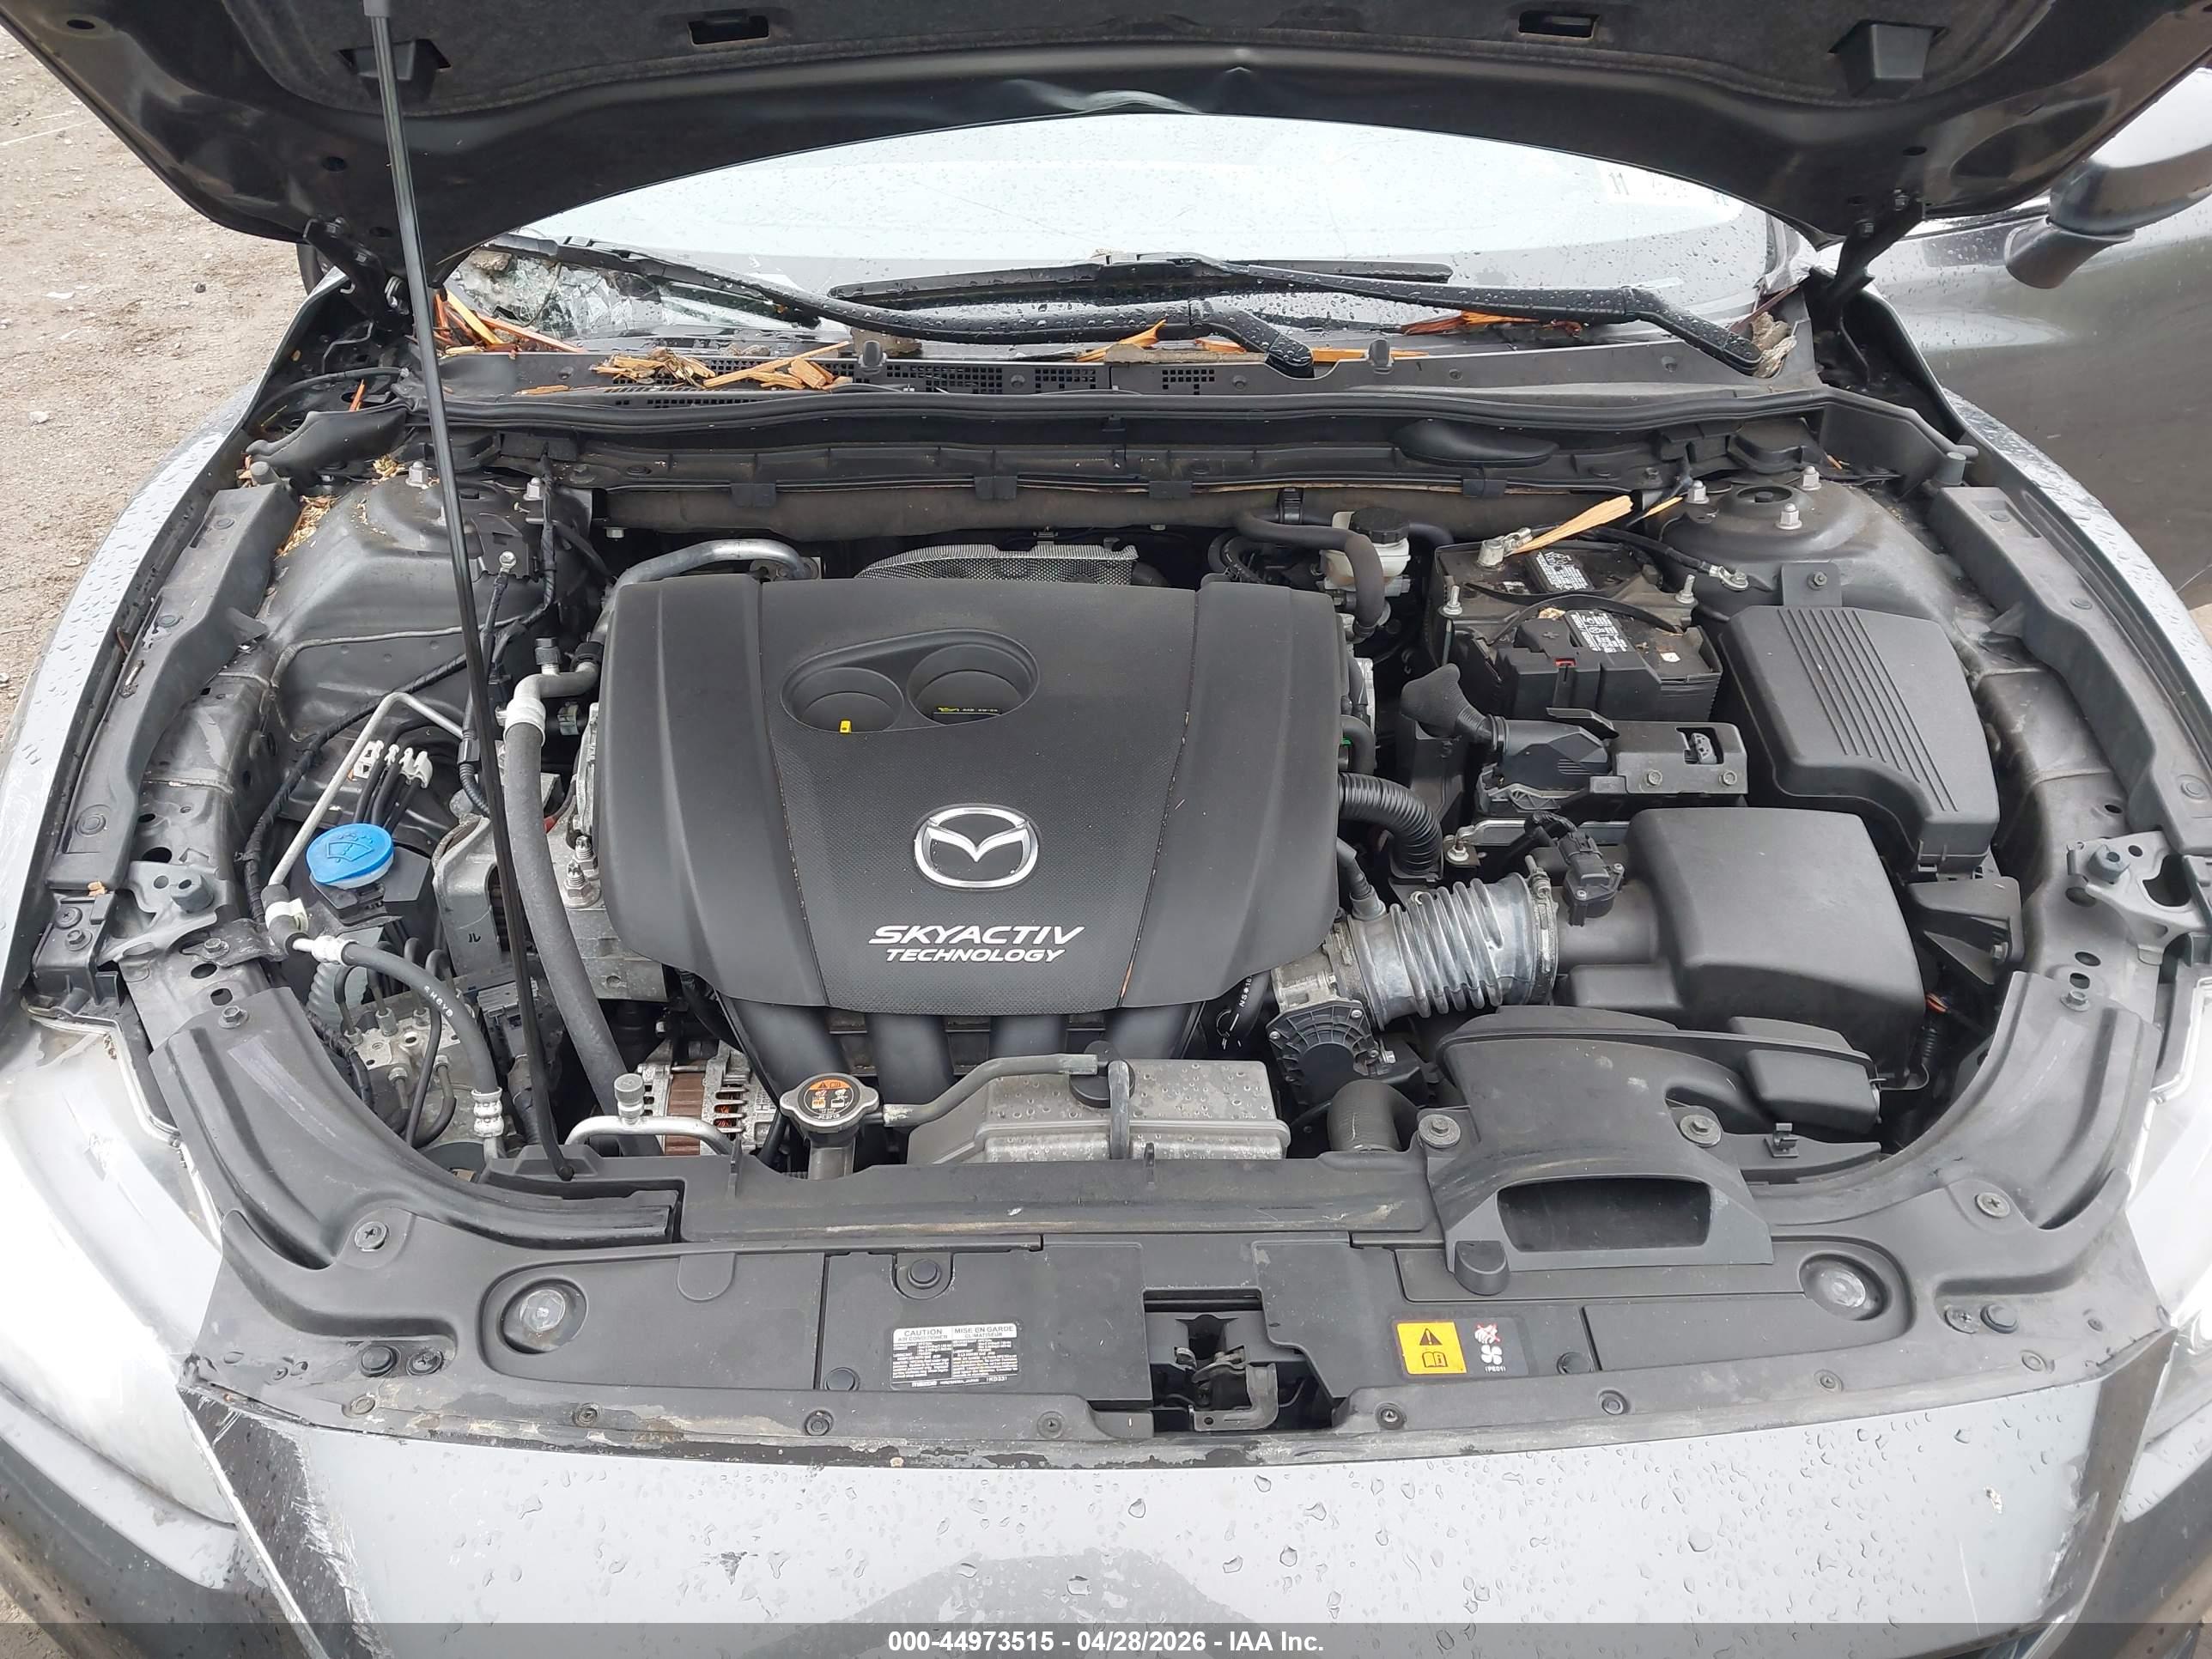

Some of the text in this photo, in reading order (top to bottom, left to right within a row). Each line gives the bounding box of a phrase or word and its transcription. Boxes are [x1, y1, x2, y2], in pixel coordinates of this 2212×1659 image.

[868, 925, 1085, 945] SKYACTIV
[886, 948, 1066, 963] TECHNOLOGY
[904, 1328, 943, 1337] CAUTION
